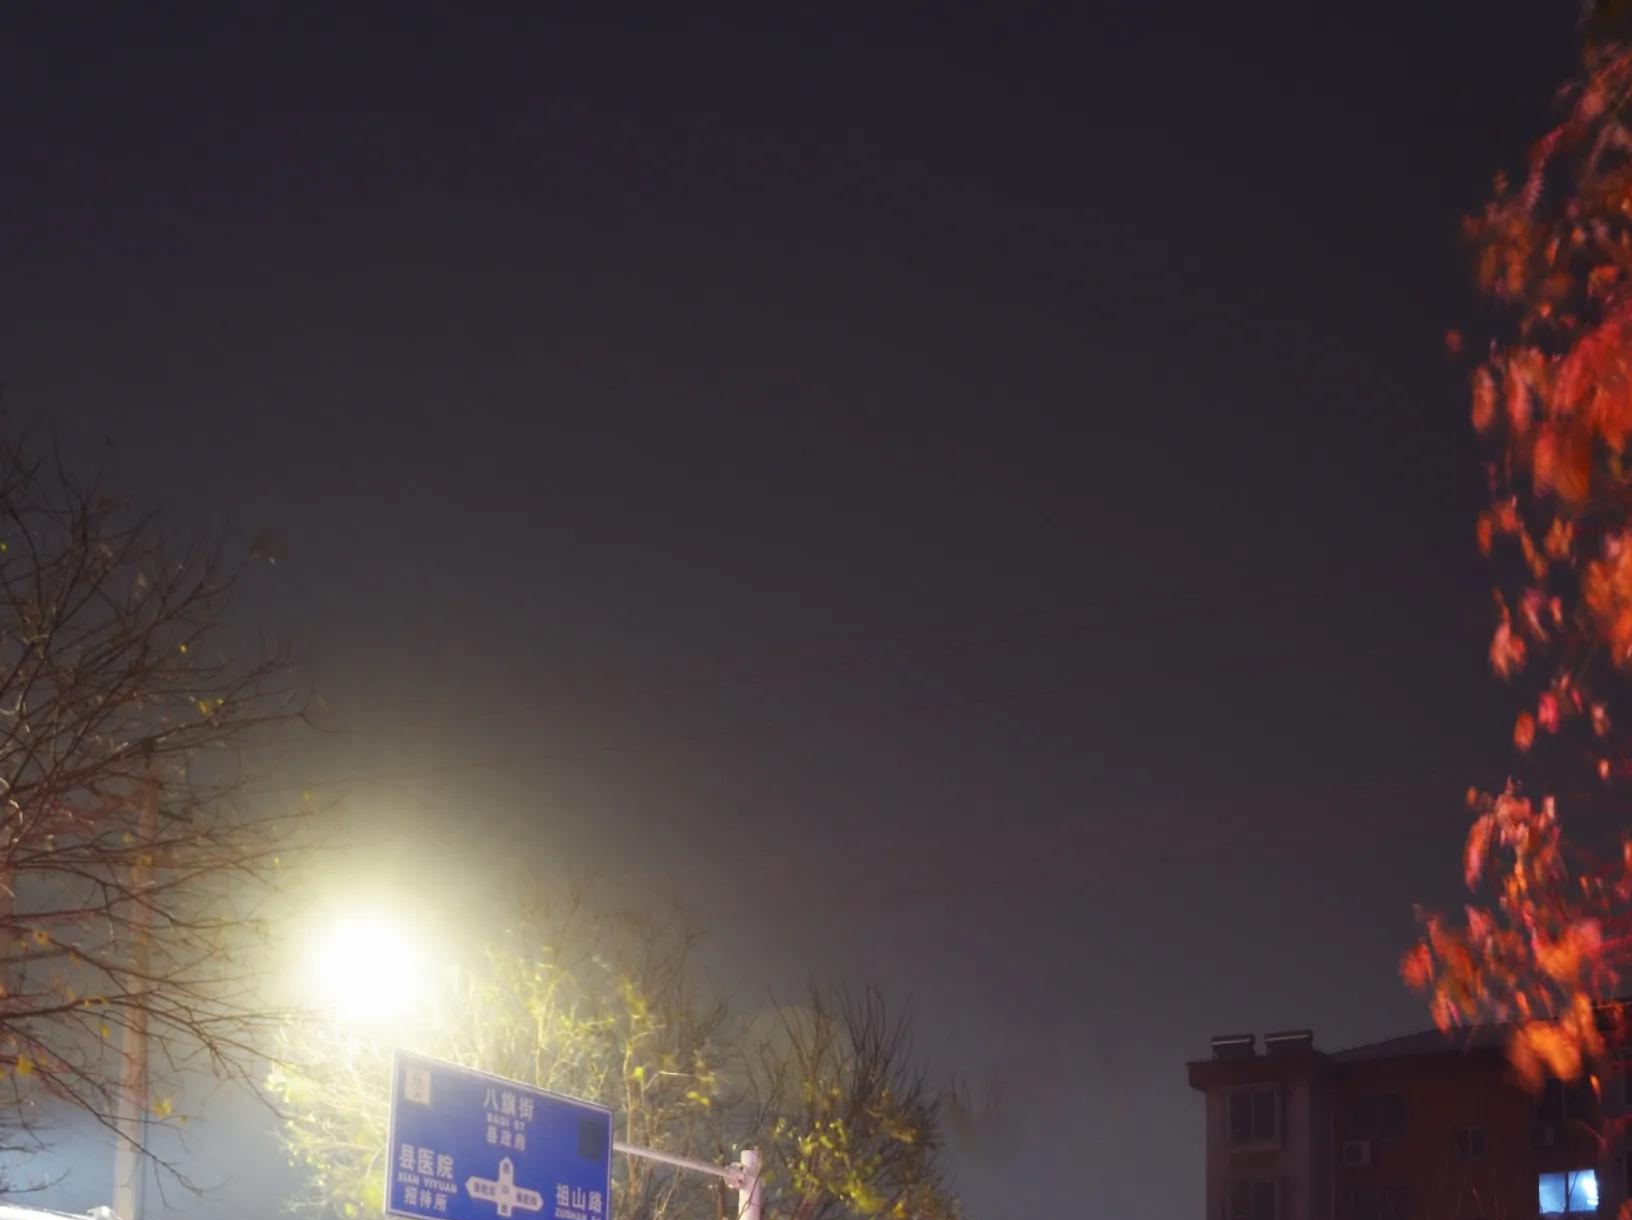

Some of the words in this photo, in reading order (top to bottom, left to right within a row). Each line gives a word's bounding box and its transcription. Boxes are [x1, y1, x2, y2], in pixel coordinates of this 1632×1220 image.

[399, 1144, 454, 1179] 县医院
[404, 1186, 448, 1212] 招待所
[555, 1182, 602, 1214] 祖山路
